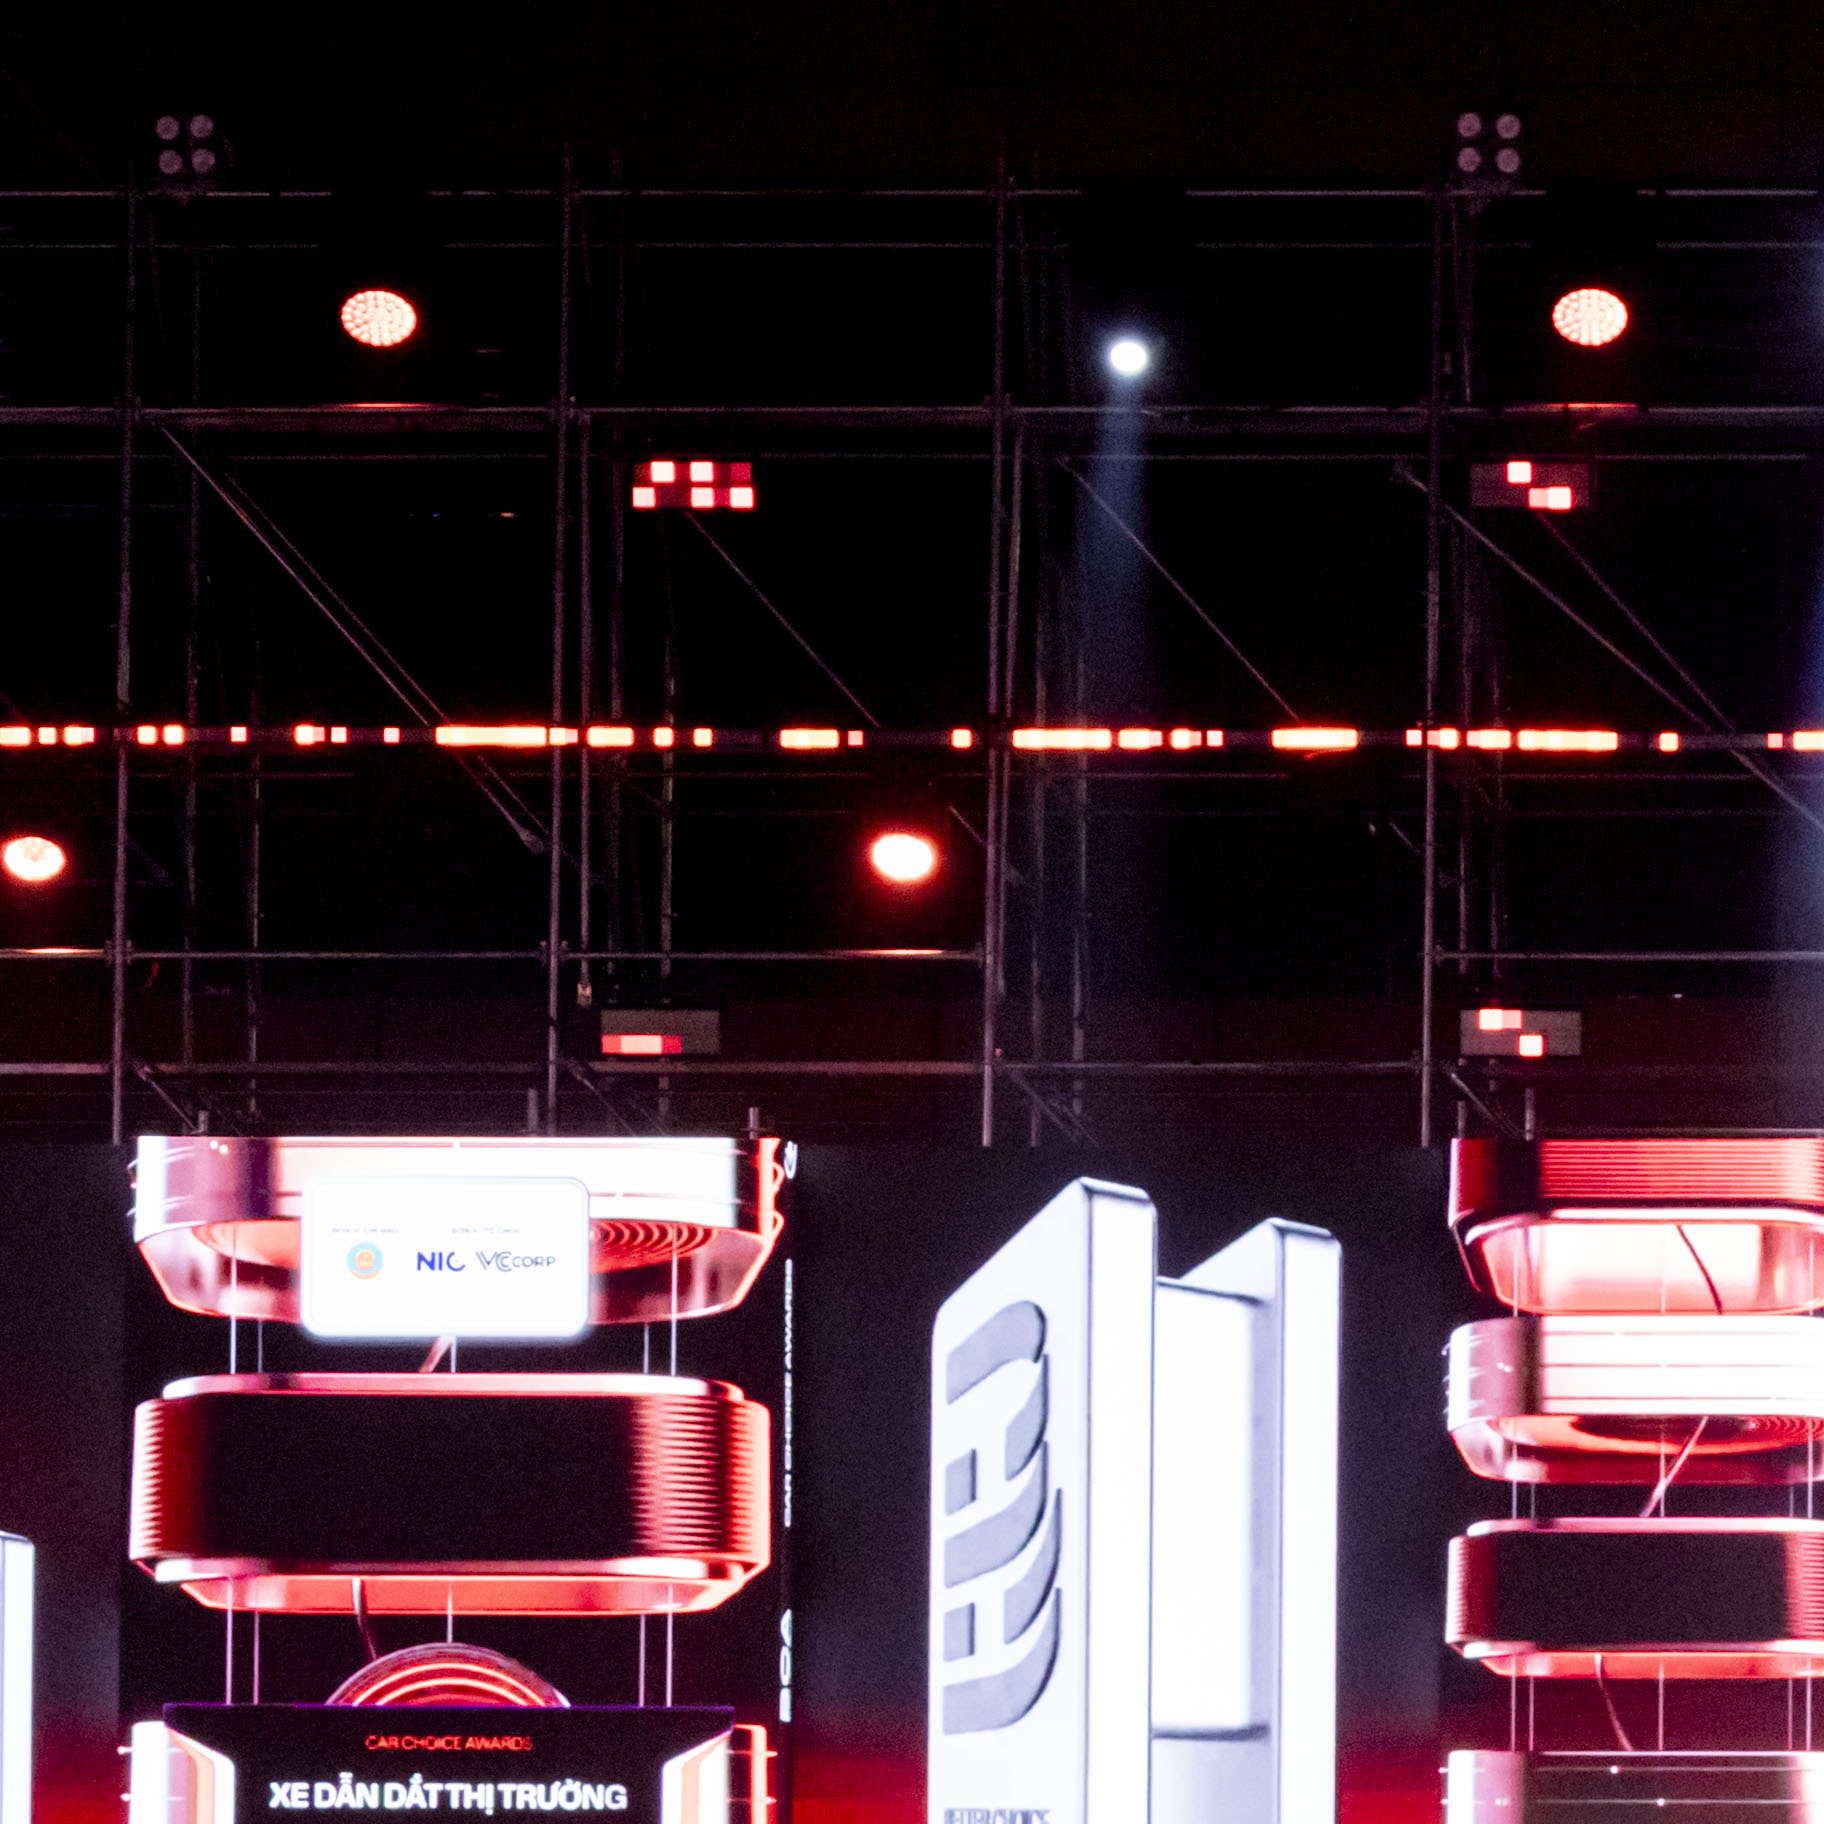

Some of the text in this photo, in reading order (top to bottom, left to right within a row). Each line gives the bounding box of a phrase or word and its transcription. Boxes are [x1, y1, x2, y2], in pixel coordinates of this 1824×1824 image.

[417, 1251, 466, 1272] NIC
[365, 1735, 533, 1751] CAR CHOICE AWARDS
[269, 1781, 310, 1808] XE
[445, 1782, 495, 1816] THỊ
[497, 1778, 628, 1810] TRƯỜNG
